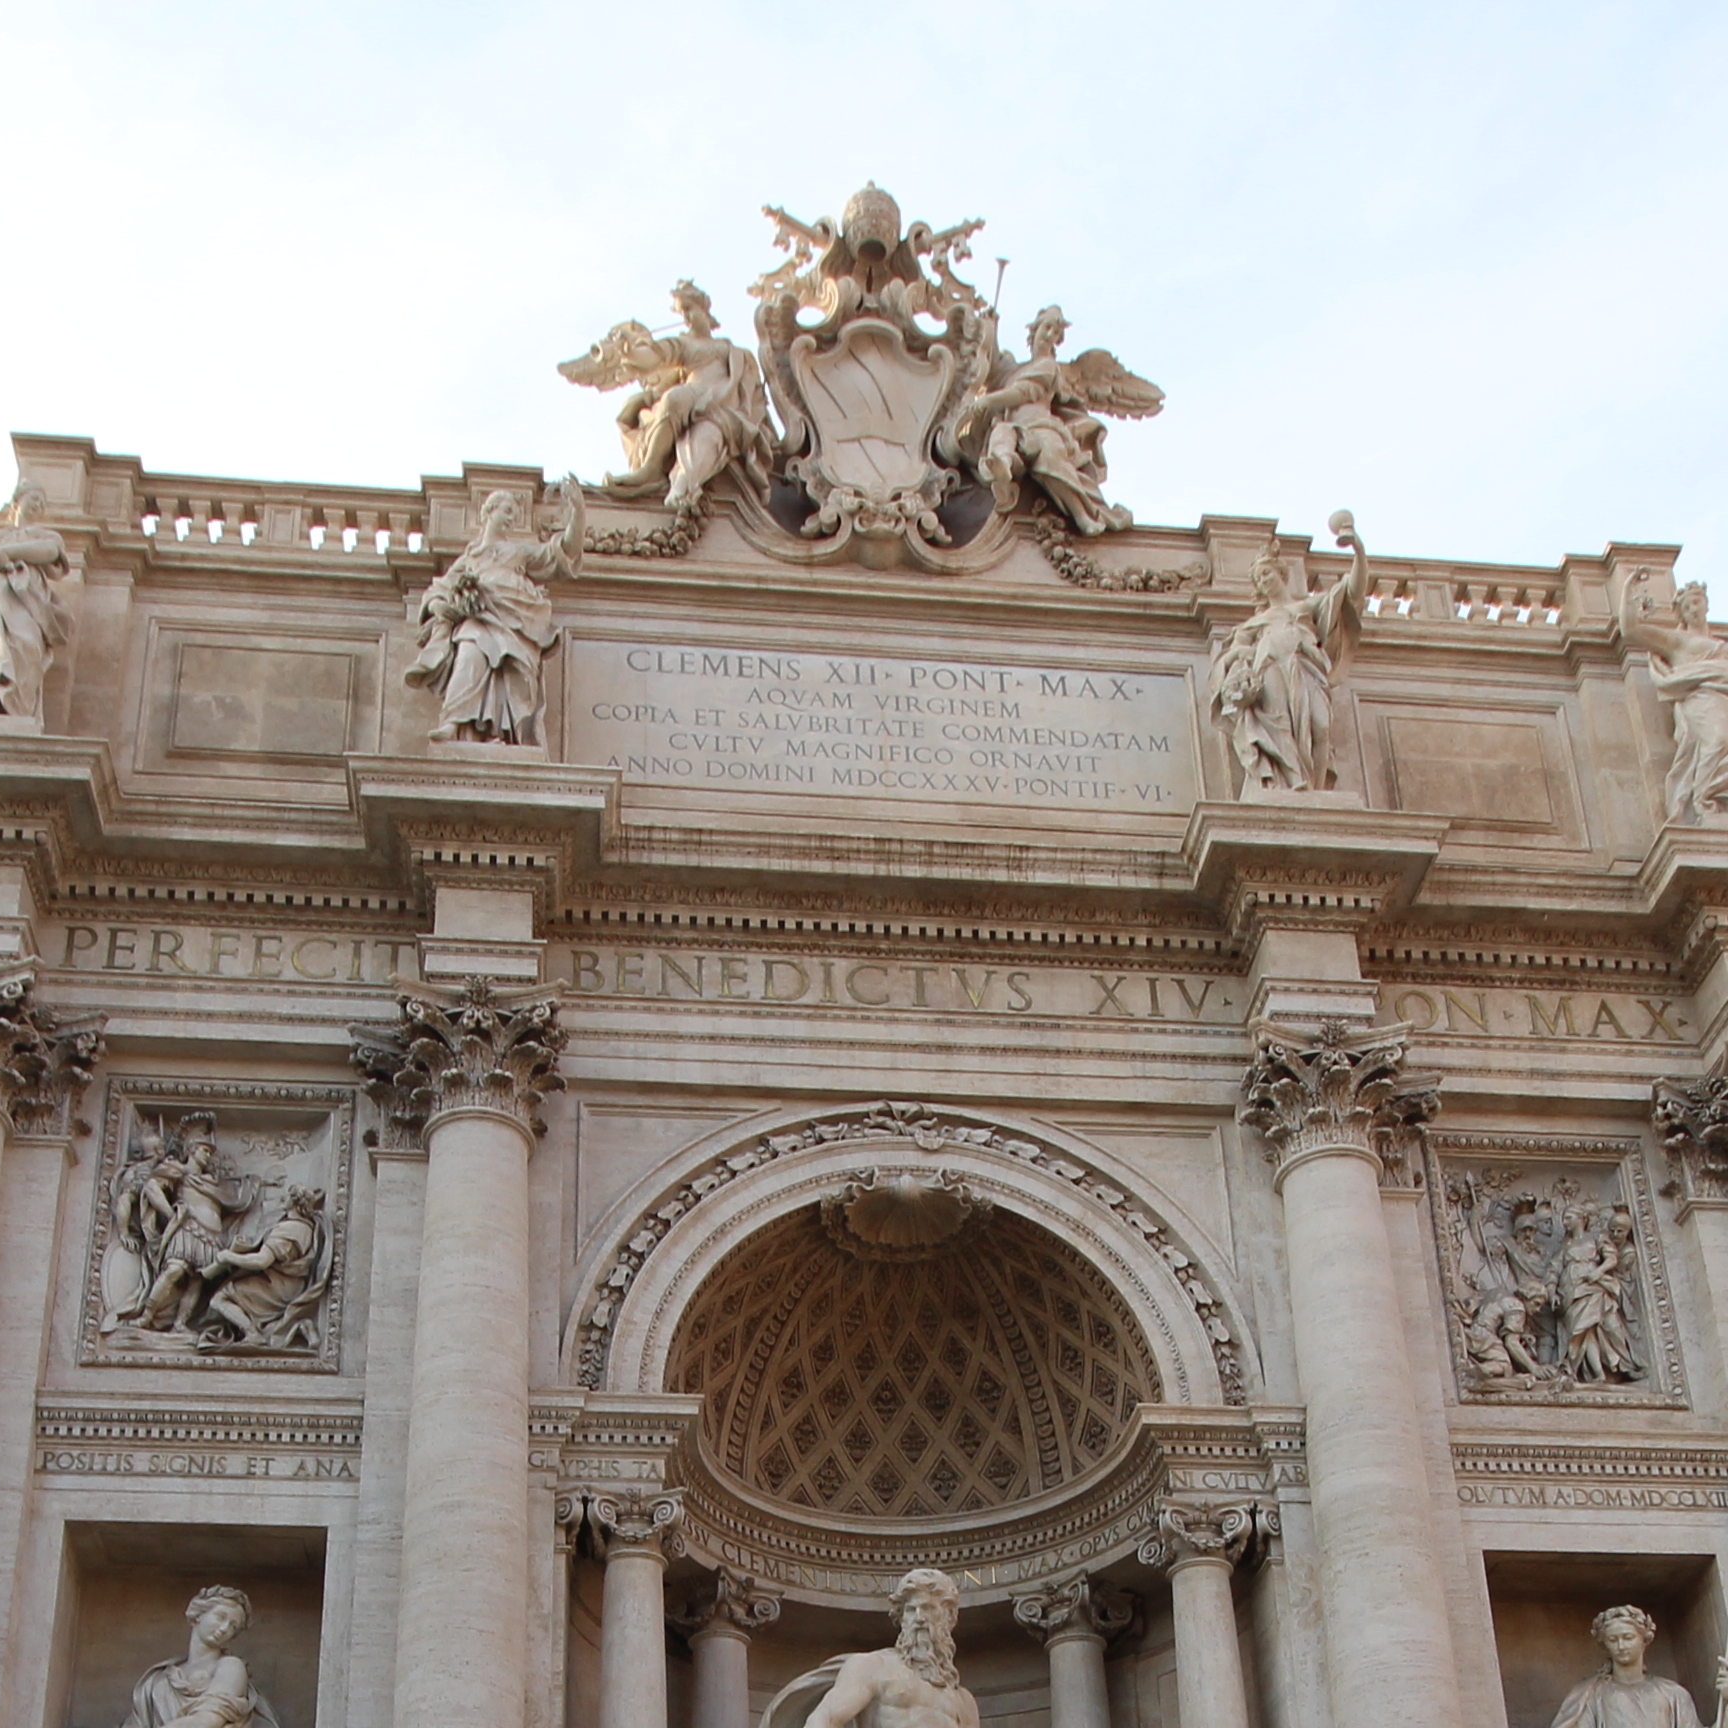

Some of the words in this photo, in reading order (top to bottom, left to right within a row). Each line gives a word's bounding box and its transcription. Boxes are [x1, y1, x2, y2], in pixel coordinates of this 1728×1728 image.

[627, 650, 801, 681] CLEMENS
[747, 687, 853, 711] AQVAM
[874, 694, 1021, 719] VIRGINEM
[592, 703, 678, 724] COPIA
[695, 708, 725, 727] ET
[738, 711, 924, 738] SALVBRITATE
[942, 723, 1169, 752] COMMENDATAM
[607, 755, 692, 776] ANNO
[705, 759, 815, 782] DOMINI
[669, 733, 765, 752] CVLTV
[786, 739, 954, 765] MAGNIFICO
[970, 750, 1101, 773] ORNAVIT
[58, 926, 416, 982] PERFECIT
[570, 950, 1033, 1012] BENEDICTVS
[1376, 987, 1513, 1033] ON·
[42, 1451, 134, 1472] POSITIS
[148, 1453, 227, 1475] SIGNIS
[245, 1456, 275, 1476] ET
[293, 1458, 354, 1477] ANA
[632, 1461, 664, 1480] TA
[1278, 1465, 1306, 1483] AB
[1457, 1486, 1546, 1506] OLVTVM
[1079, 1526, 1119, 1556] OPVS
